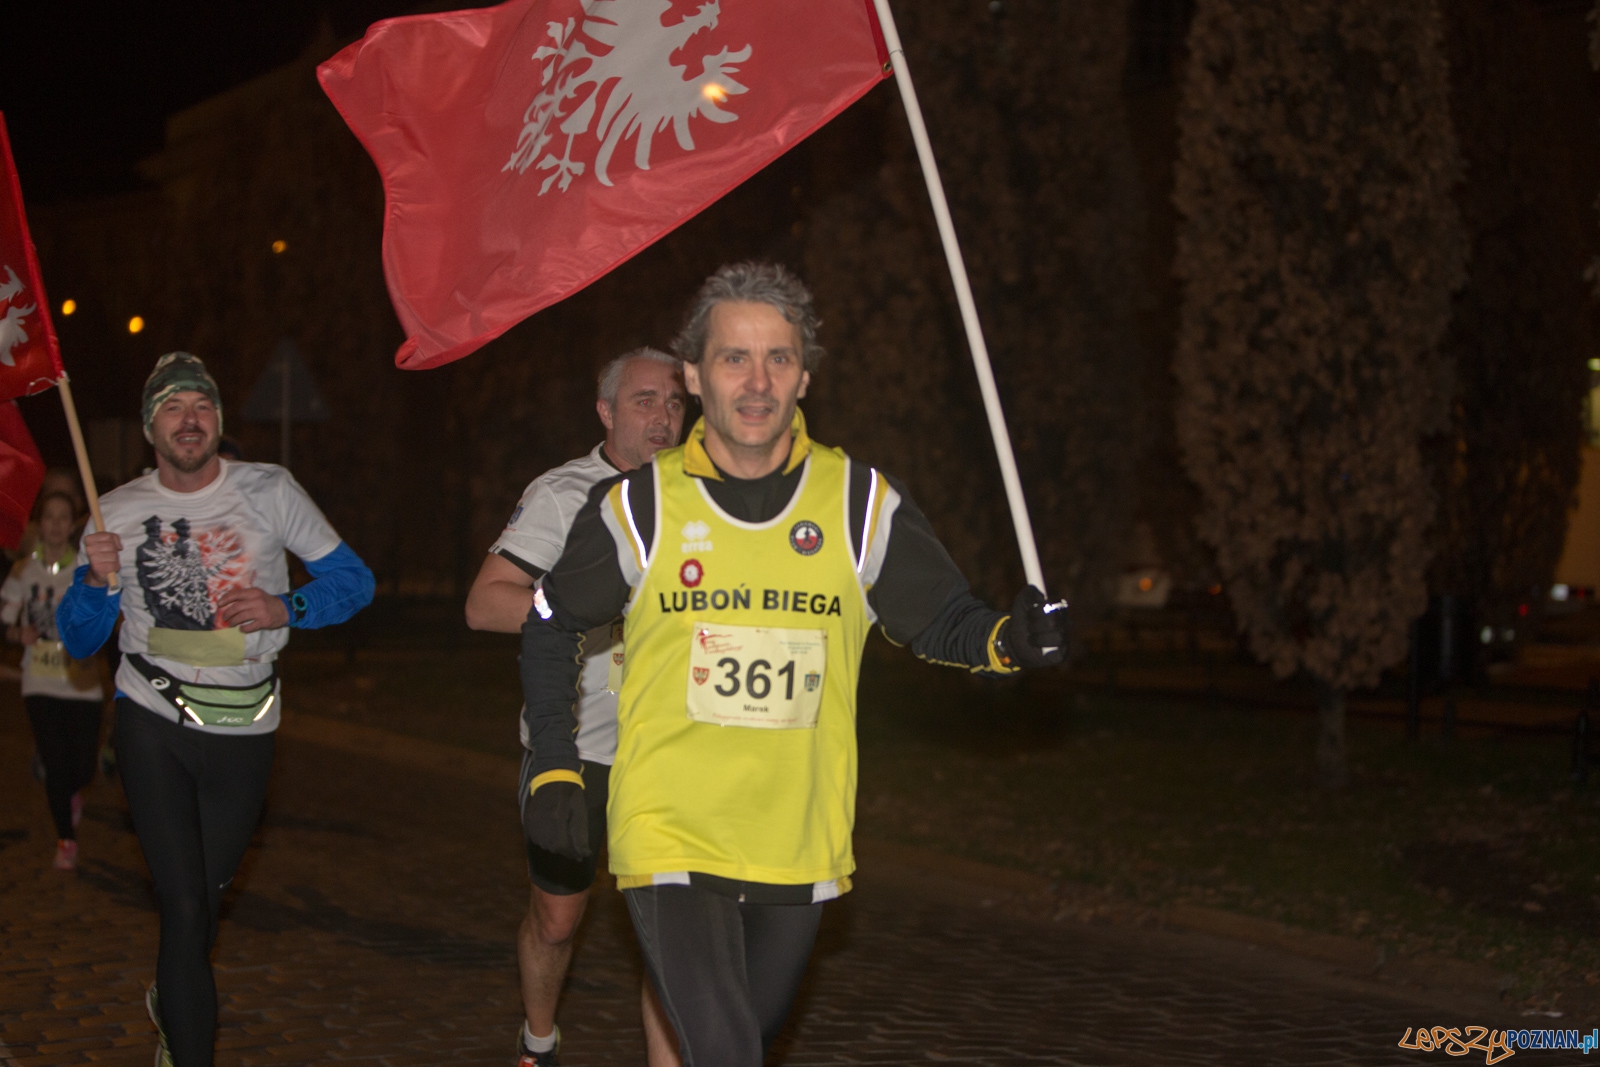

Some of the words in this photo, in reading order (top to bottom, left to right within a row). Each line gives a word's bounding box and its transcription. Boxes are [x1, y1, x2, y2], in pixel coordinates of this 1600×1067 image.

[659, 583, 751, 614] LUBOŃ
[763, 589, 842, 617] BIEGA
[714, 657, 795, 700] 361
[743, 704, 769, 713] Marek
